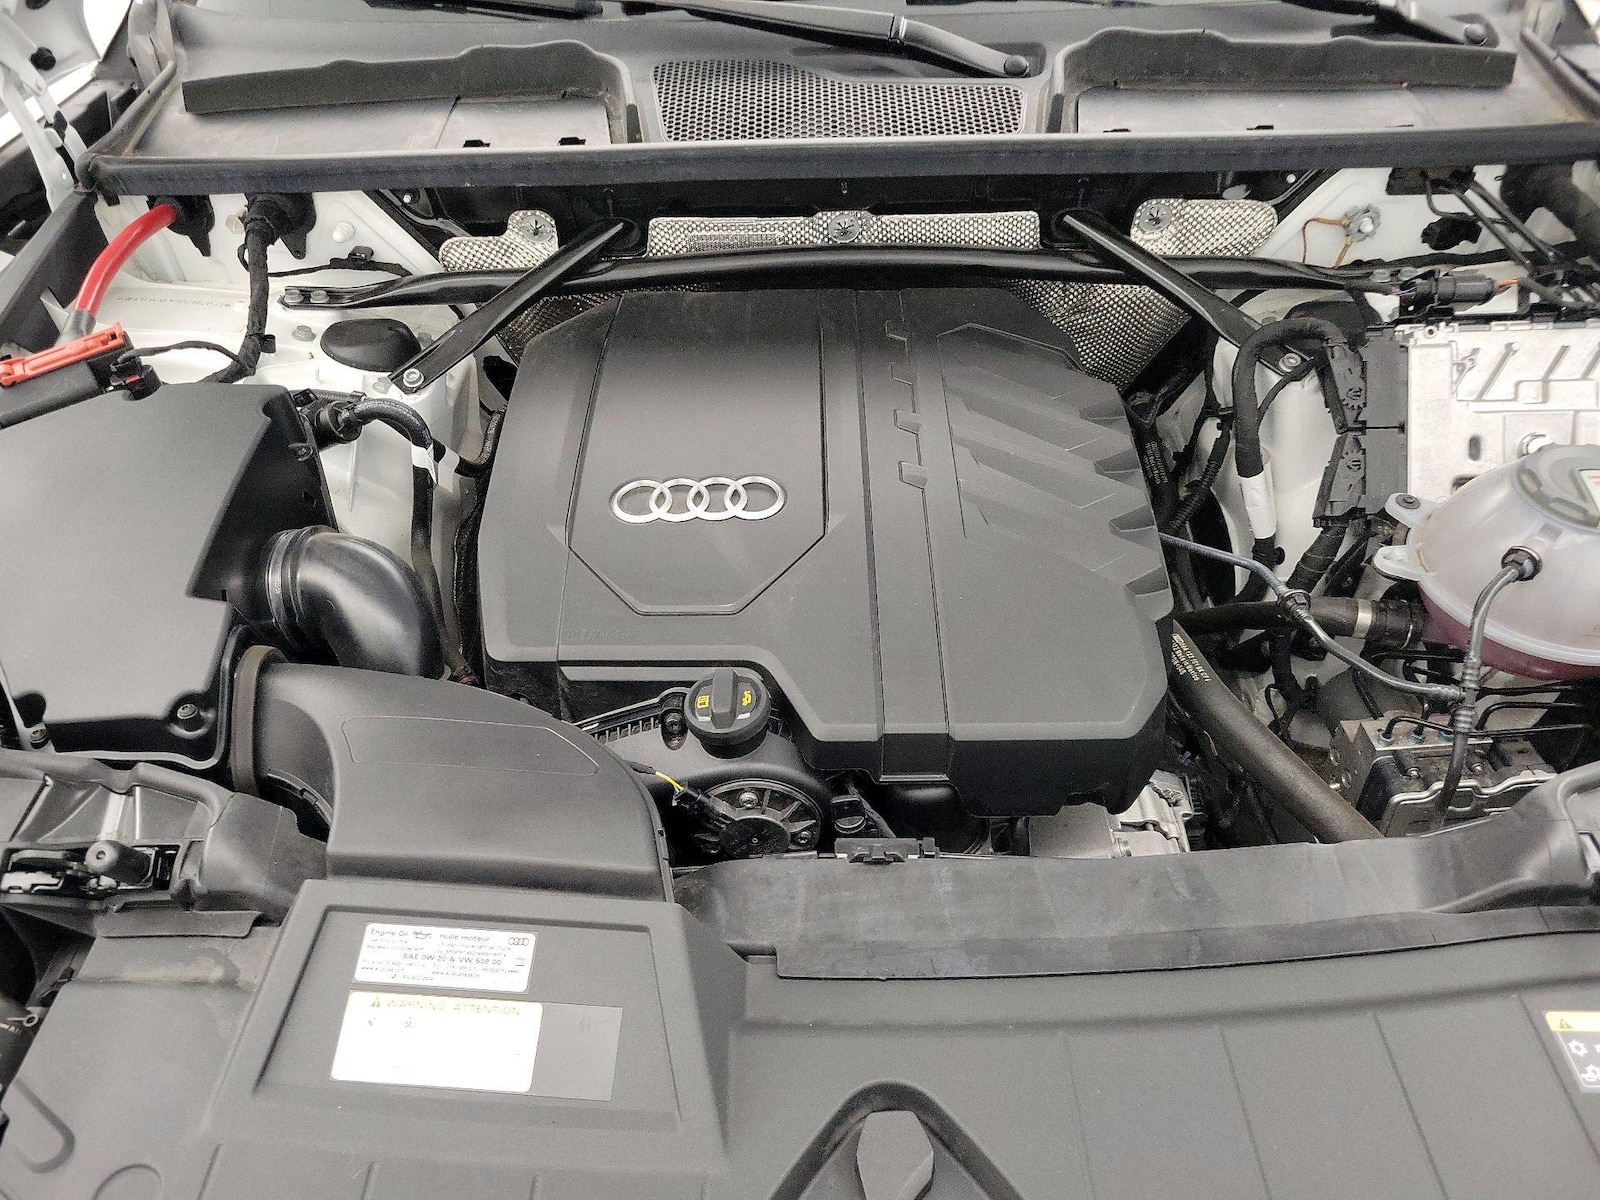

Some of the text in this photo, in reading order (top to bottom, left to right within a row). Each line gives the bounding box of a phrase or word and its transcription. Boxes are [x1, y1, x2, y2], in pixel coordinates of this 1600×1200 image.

[370, 928, 409, 937] Engine Oil
[440, 933, 490, 943] Huile moteur
[421, 954, 449, 962] 0W-20
[459, 956, 473, 964] VW
[387, 1000, 521, 1016] WARNING ATTENTION
